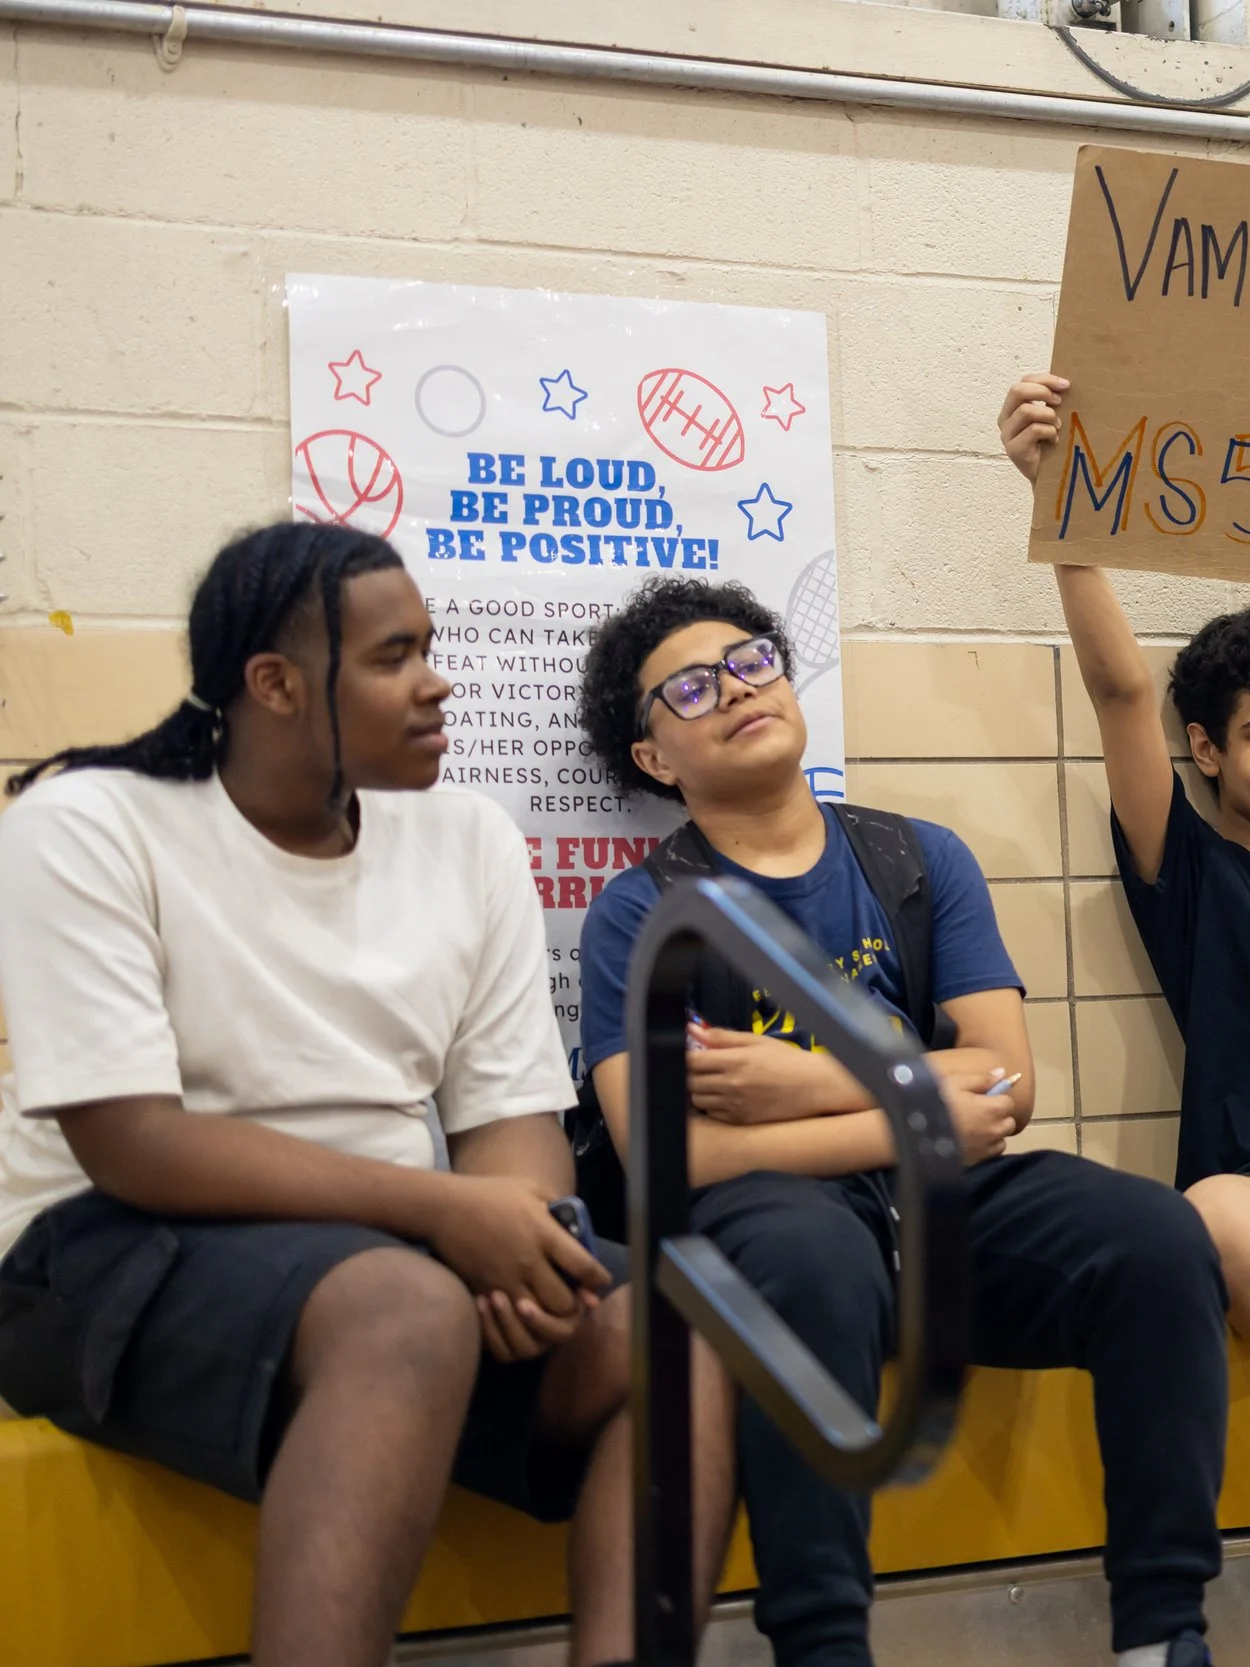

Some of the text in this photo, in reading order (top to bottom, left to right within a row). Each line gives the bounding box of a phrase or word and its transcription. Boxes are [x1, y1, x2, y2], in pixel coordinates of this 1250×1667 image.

[467, 452, 666, 499] BE LOUD,
[450, 490, 683, 537] BE PROUD,
[427, 529, 720, 570] BE POSITIVE!
[446, 598, 460, 616] A
[469, 599, 535, 617] GOOD
[488, 628, 534, 646] CAN
[544, 629, 600, 647] TAKE
[496, 656, 588, 674] WITHOU
[548, 713, 578, 729] AN
[442, 766, 549, 787] AIRNESS,
[530, 796, 632, 813] RESPECT.
